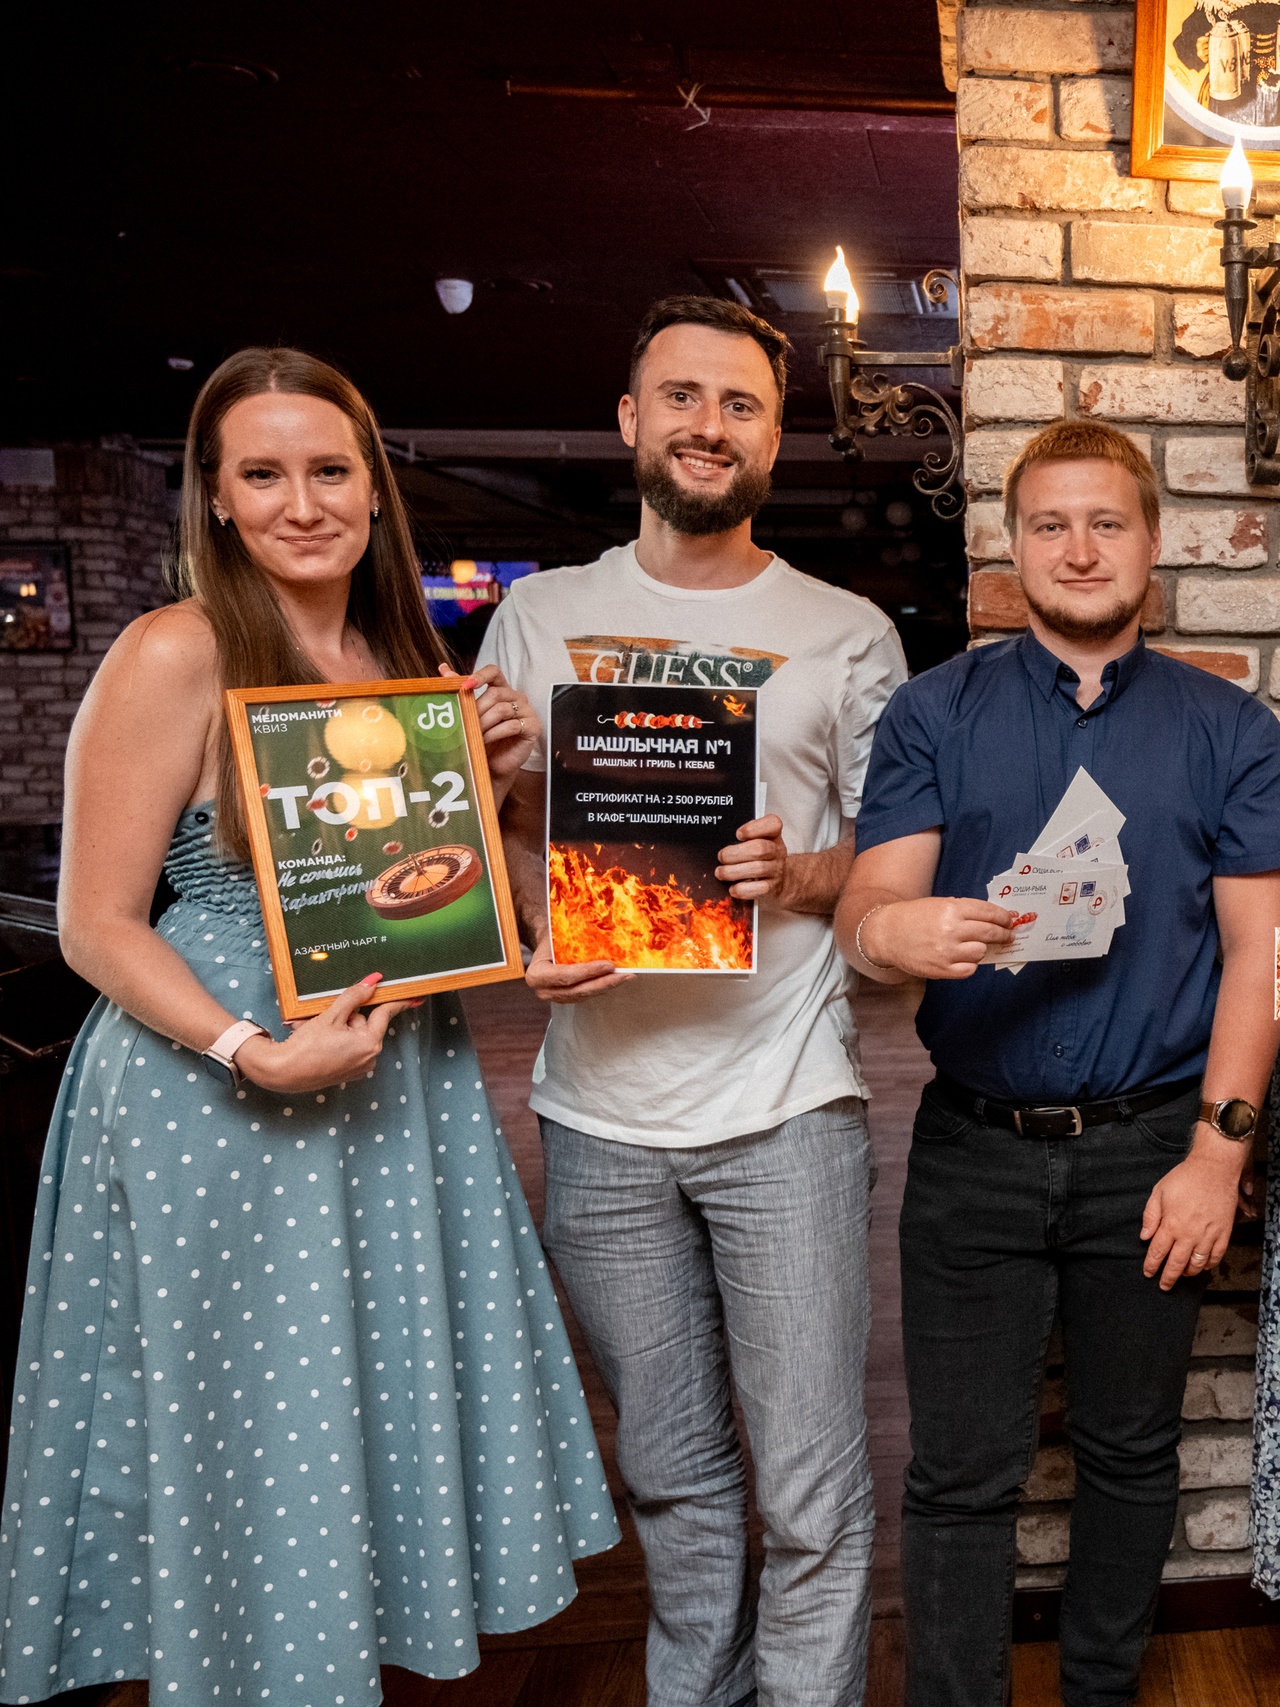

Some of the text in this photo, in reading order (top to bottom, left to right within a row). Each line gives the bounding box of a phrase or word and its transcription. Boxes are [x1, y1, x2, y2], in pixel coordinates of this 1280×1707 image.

[251, 708, 342, 723] МЕЛОМАНИТИ
[253, 723, 288, 734] КВИЗ
[576, 736, 699, 754] ШАШЛЫЧНАЯ
[593, 758, 715, 769] ШАШЛЫК ГРИЛЬ КЕБАБ
[267, 770, 470, 830] ТОП-2
[575, 792, 644, 803] СЕРТИФИКАТ
[645, 794, 660, 804] НА
[675, 795, 693, 804] 500
[695, 794, 734, 806] РУБЛЕЙ
[588, 813, 595, 822] В
[597, 813, 625, 822] КАФЕ
[278, 854, 346, 869] КОМАНДА:
[277, 869, 296, 888] Не
[294, 939, 350, 956] АЗАРТНЫЙ
[352, 936, 378, 947] ЧАРТ
